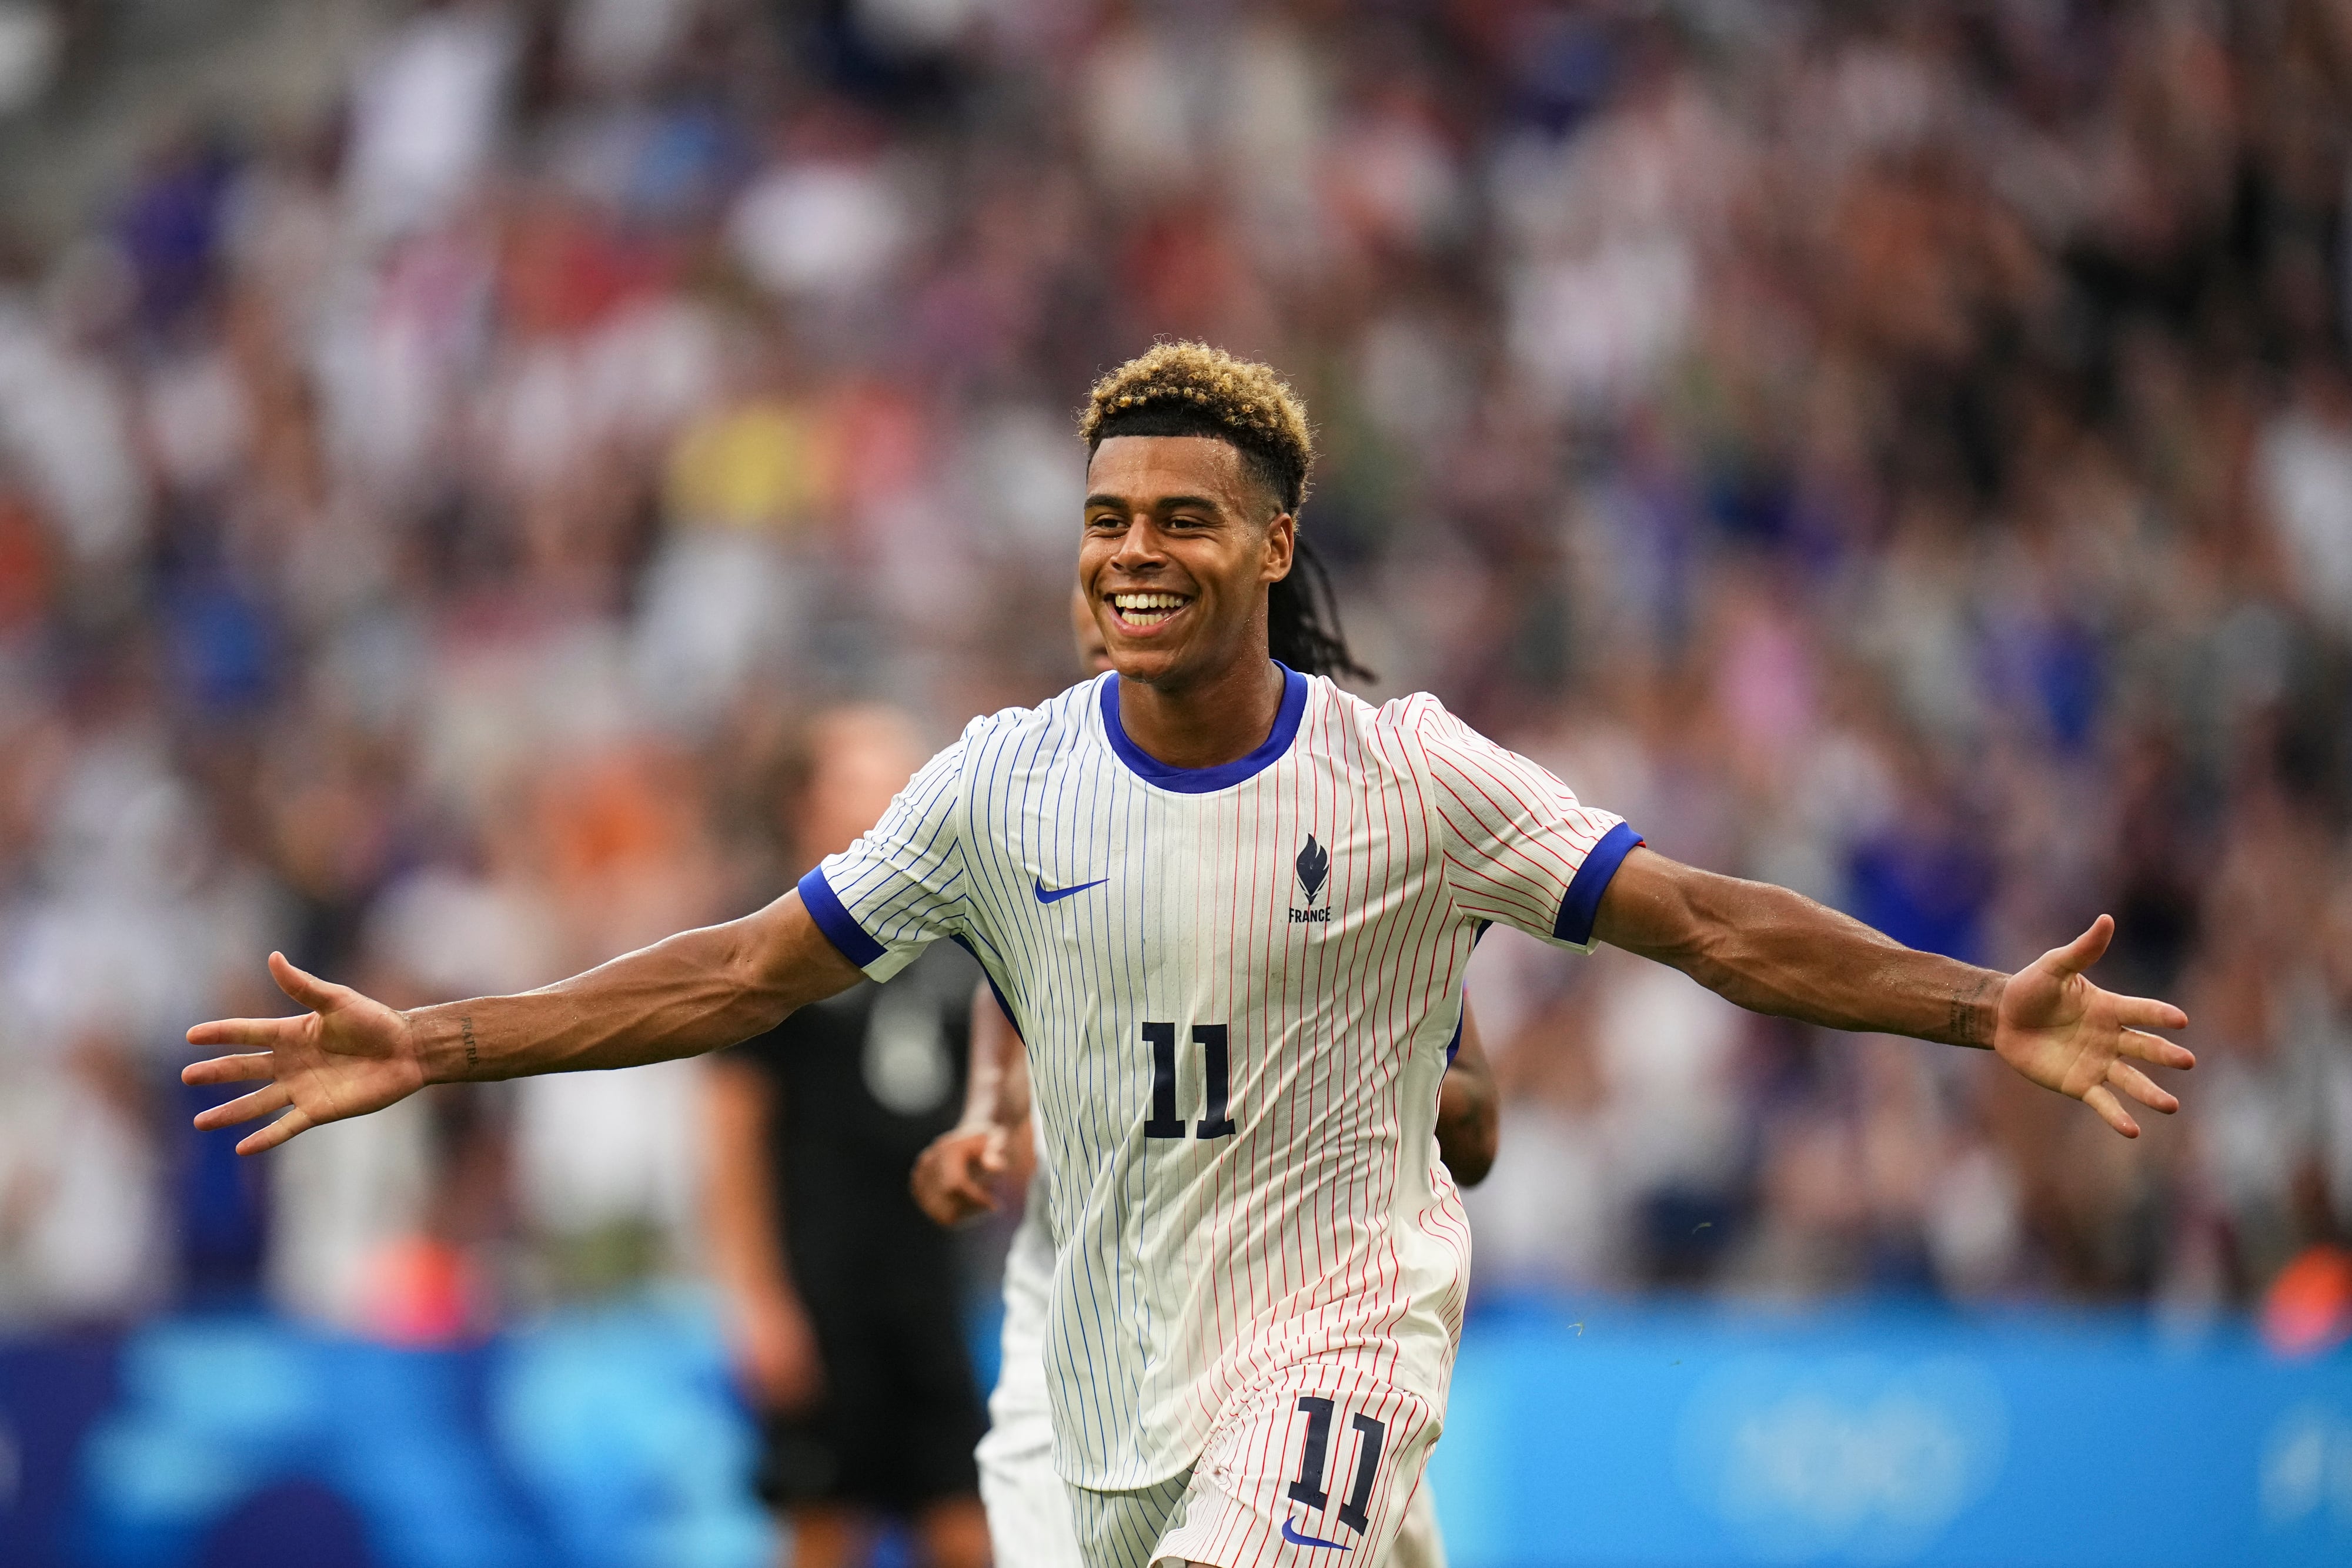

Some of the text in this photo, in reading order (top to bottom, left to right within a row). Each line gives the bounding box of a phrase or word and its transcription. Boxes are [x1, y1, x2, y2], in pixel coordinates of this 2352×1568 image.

[1288, 906, 1331, 923] FRANCE
[1142, 1022, 1236, 1139] 11
[1288, 1396, 1385, 1536] 11
